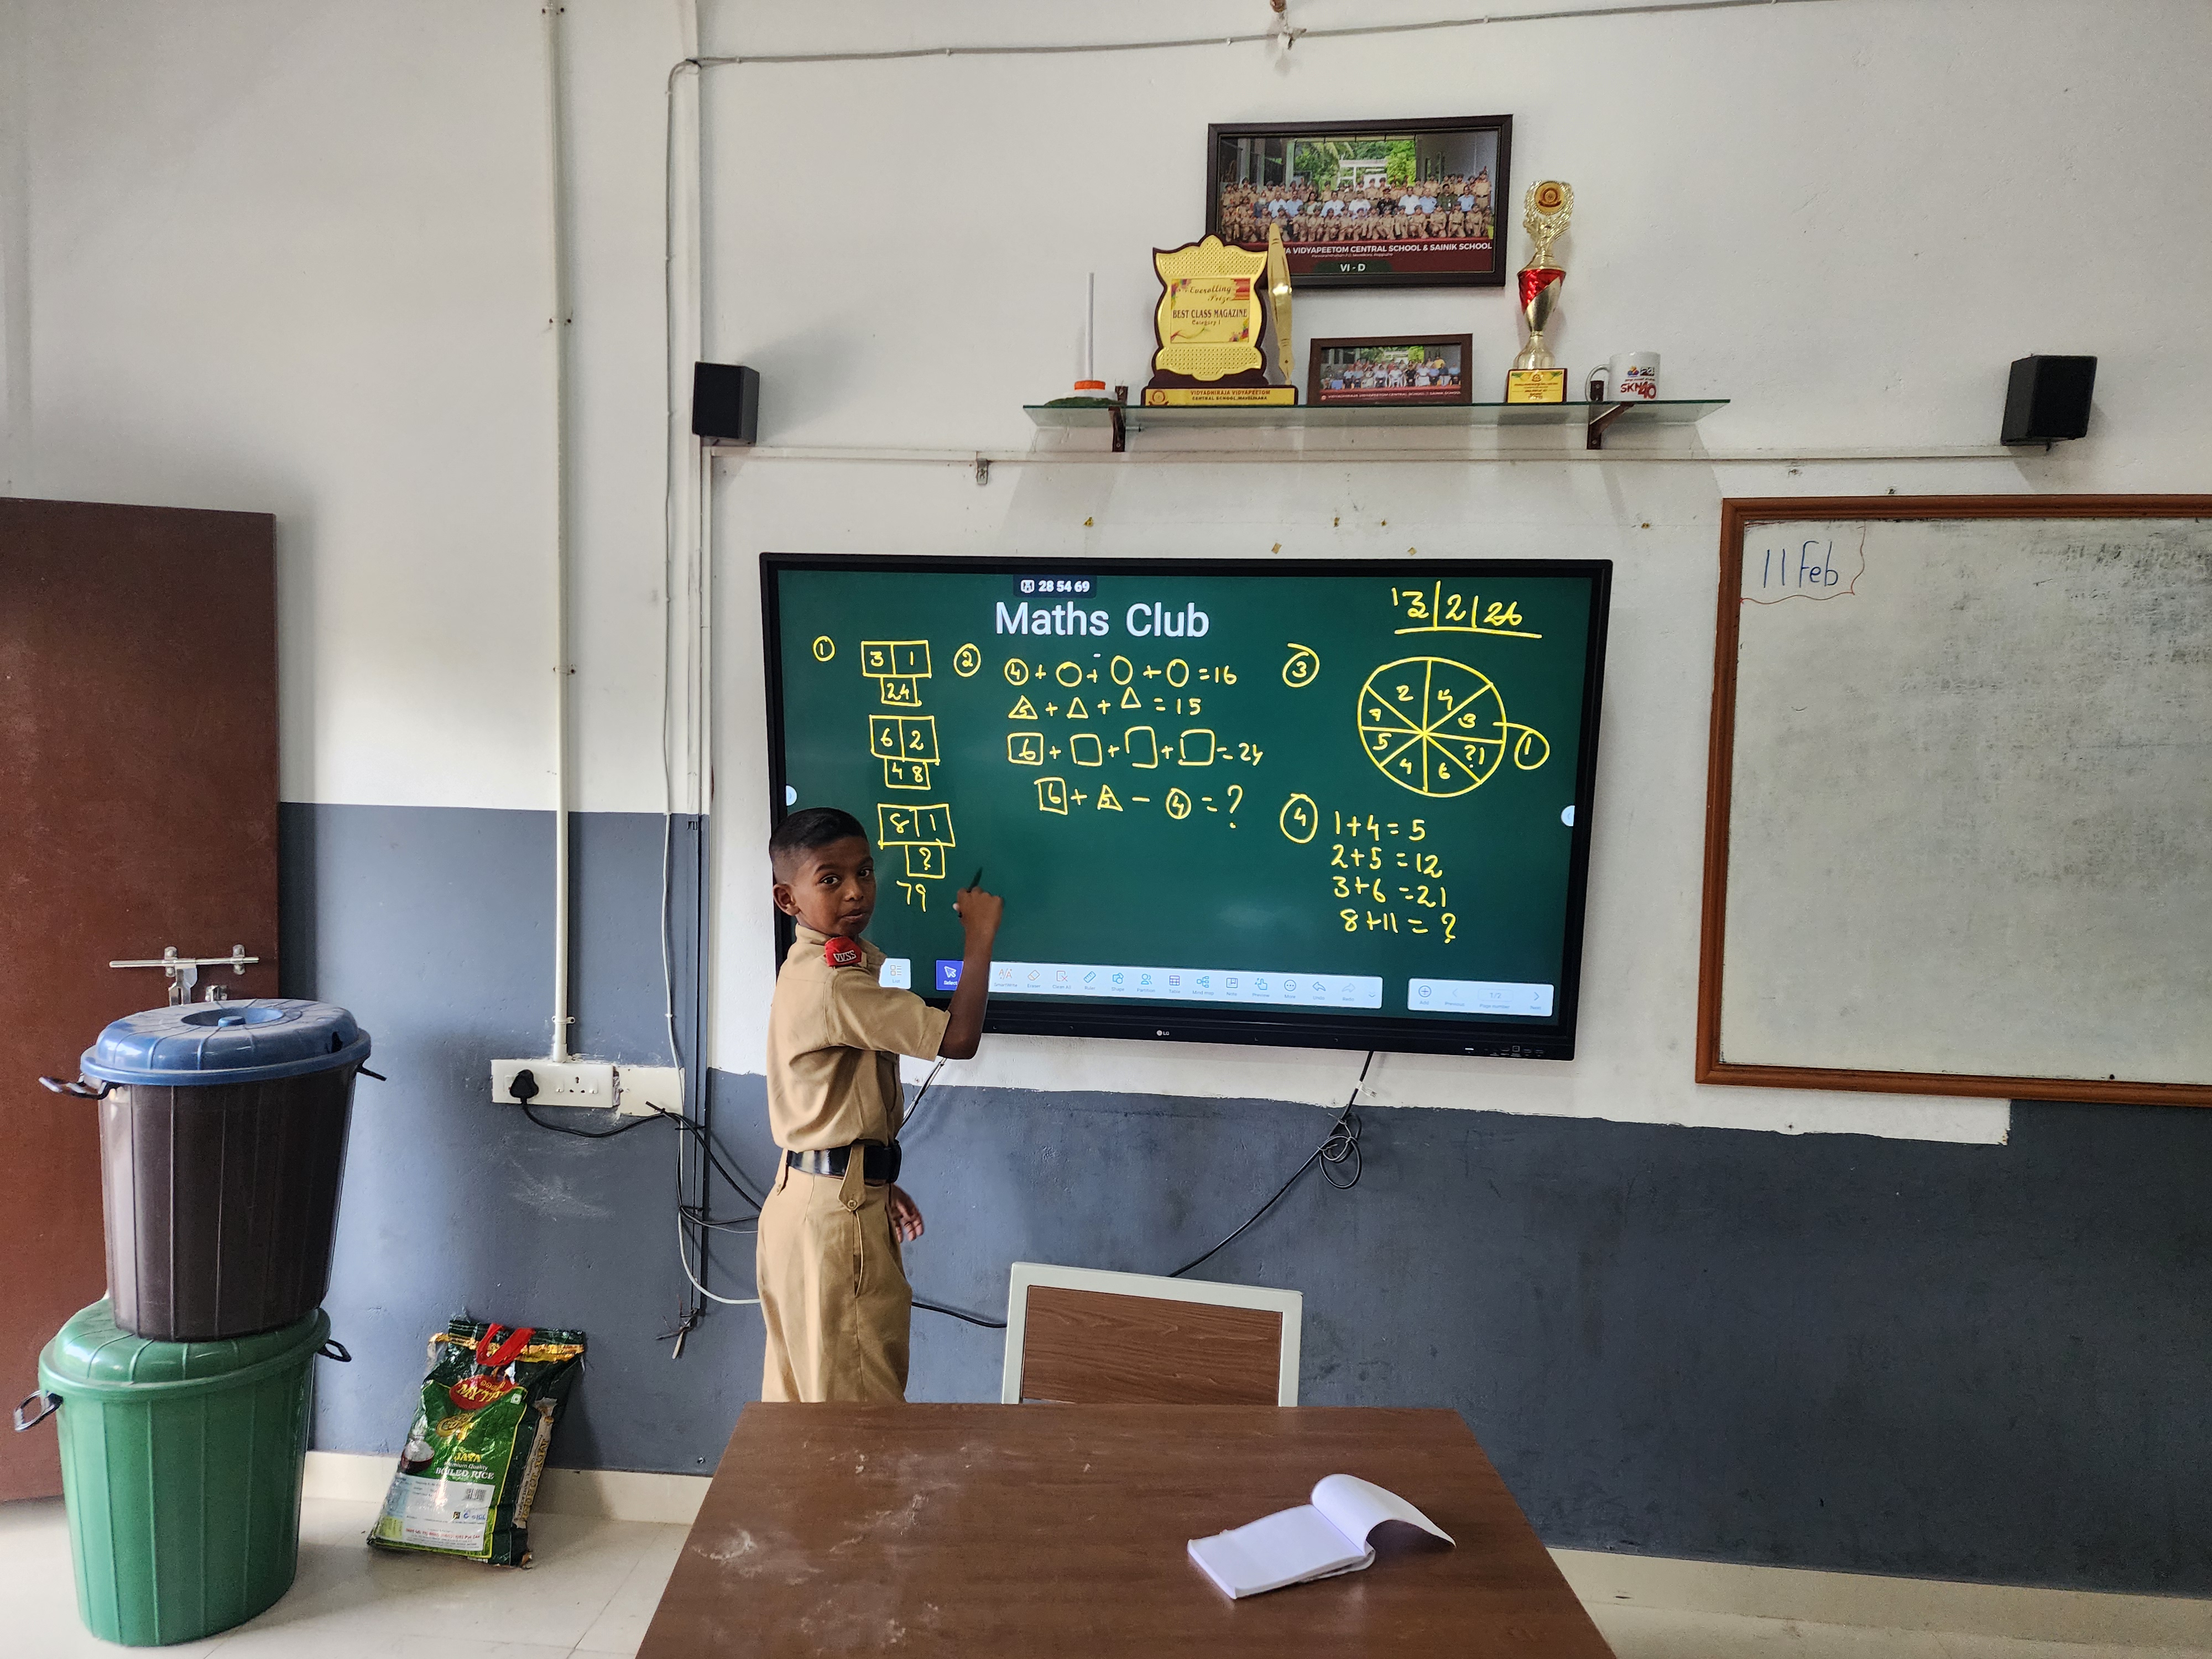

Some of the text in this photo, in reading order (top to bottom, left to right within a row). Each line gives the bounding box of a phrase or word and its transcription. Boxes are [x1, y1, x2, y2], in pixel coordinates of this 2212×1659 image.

[1293, 246, 1349, 254] VIDYAPEETOM
[1350, 245, 1387, 253] CENTRAL
[1388, 244, 1422, 252] SCHOOL
[1459, 242, 1493, 251] SCHOOL
[1340, 264, 1350, 272] VI
[1173, 309, 1248, 319] BEST CLASS MAGAZINE
[1799, 541, 1838, 588] Feb
[1039, 581, 1090, 592] 28 54 69
[996, 601, 1209, 637] Maths Club
[454, 1452, 481, 1463] JAYA
[471, 1470, 494, 1480] RICE
